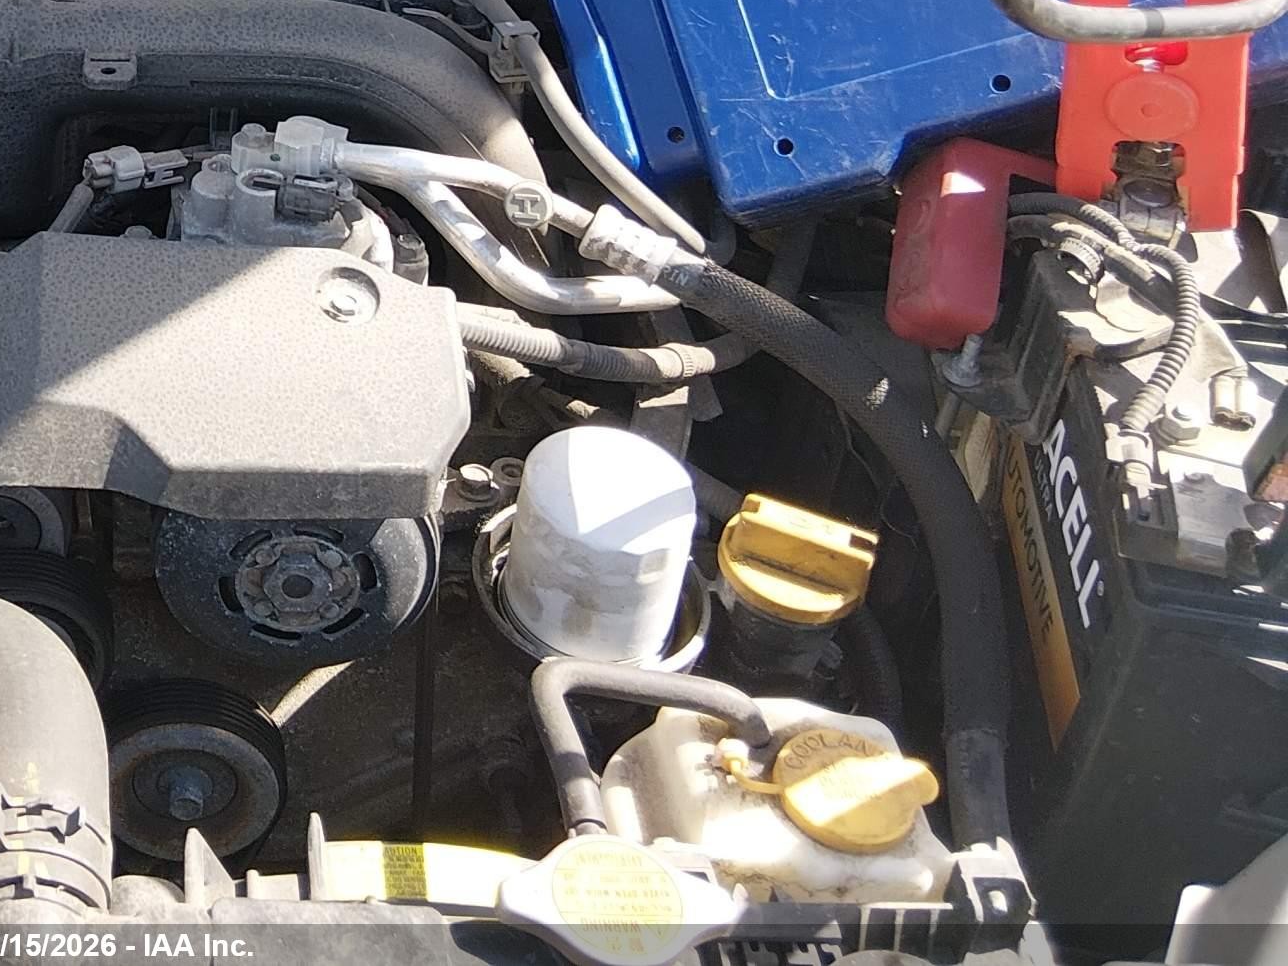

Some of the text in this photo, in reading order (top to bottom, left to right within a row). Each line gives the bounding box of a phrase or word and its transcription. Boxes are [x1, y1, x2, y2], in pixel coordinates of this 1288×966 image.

[1042, 418, 1092, 630] ACELL
[783, 732, 875, 770] COOLAN
[581, 916, 641, 933] WARNING
